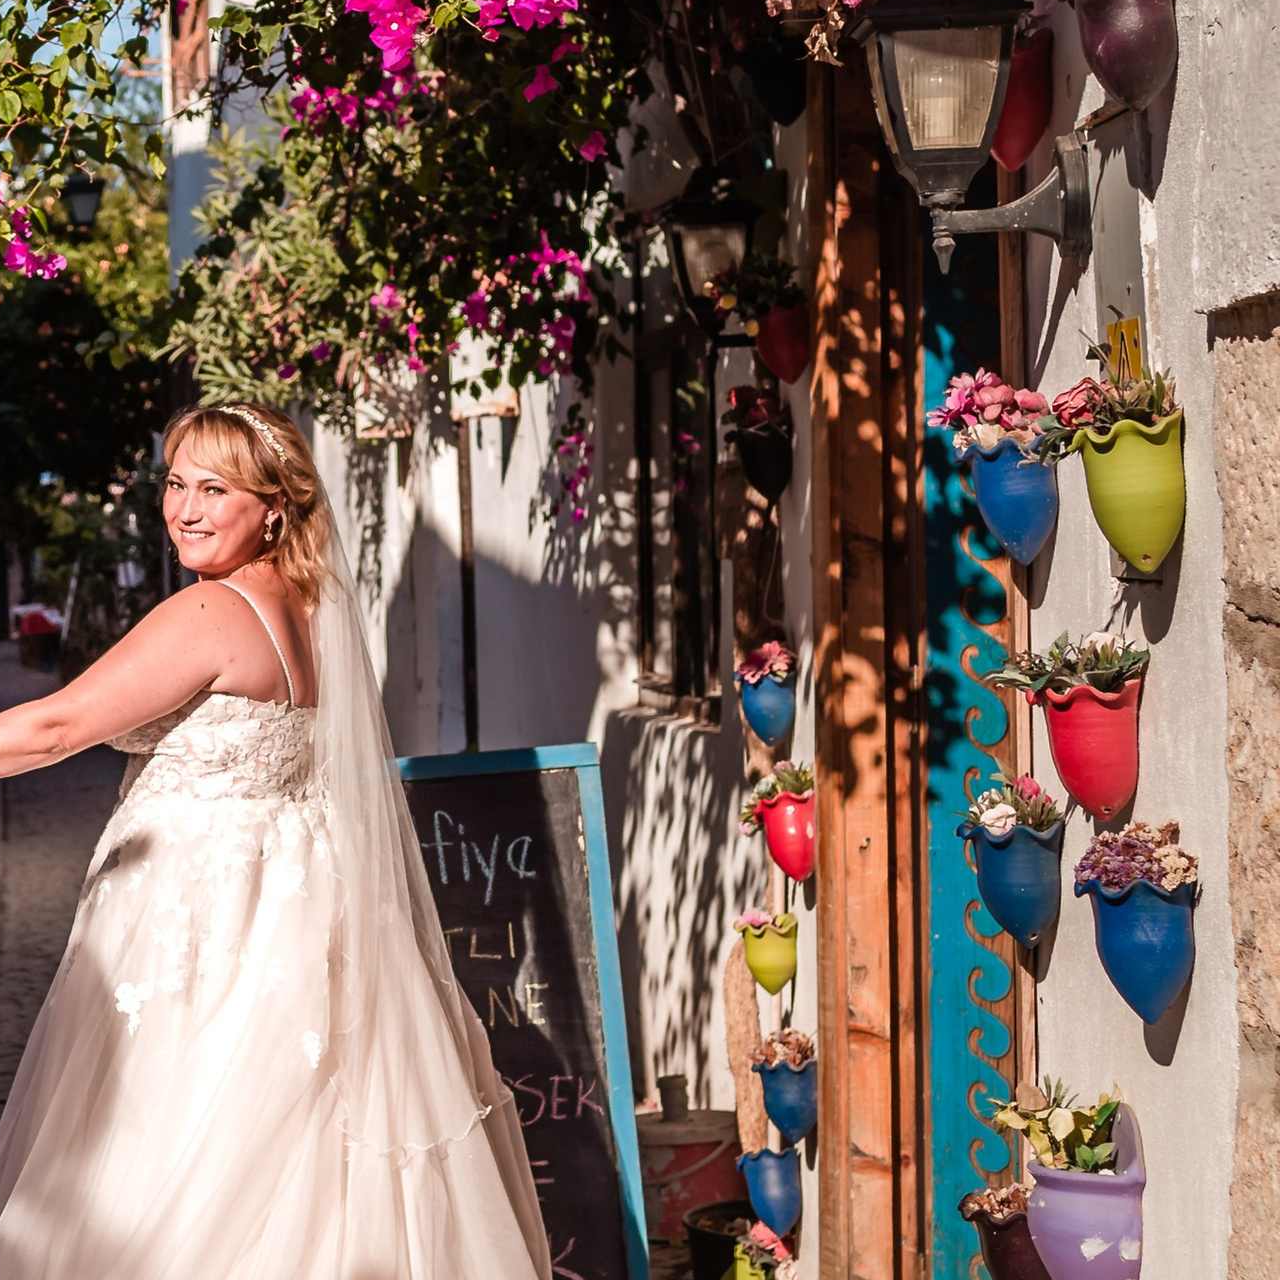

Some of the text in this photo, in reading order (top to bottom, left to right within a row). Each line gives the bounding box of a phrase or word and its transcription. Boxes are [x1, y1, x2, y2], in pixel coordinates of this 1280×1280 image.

[420, 810, 537, 906] fiye
[443, 921, 516, 962] TLI
[488, 982, 550, 1030] NE
[505, 1073, 606, 1127] SEK
